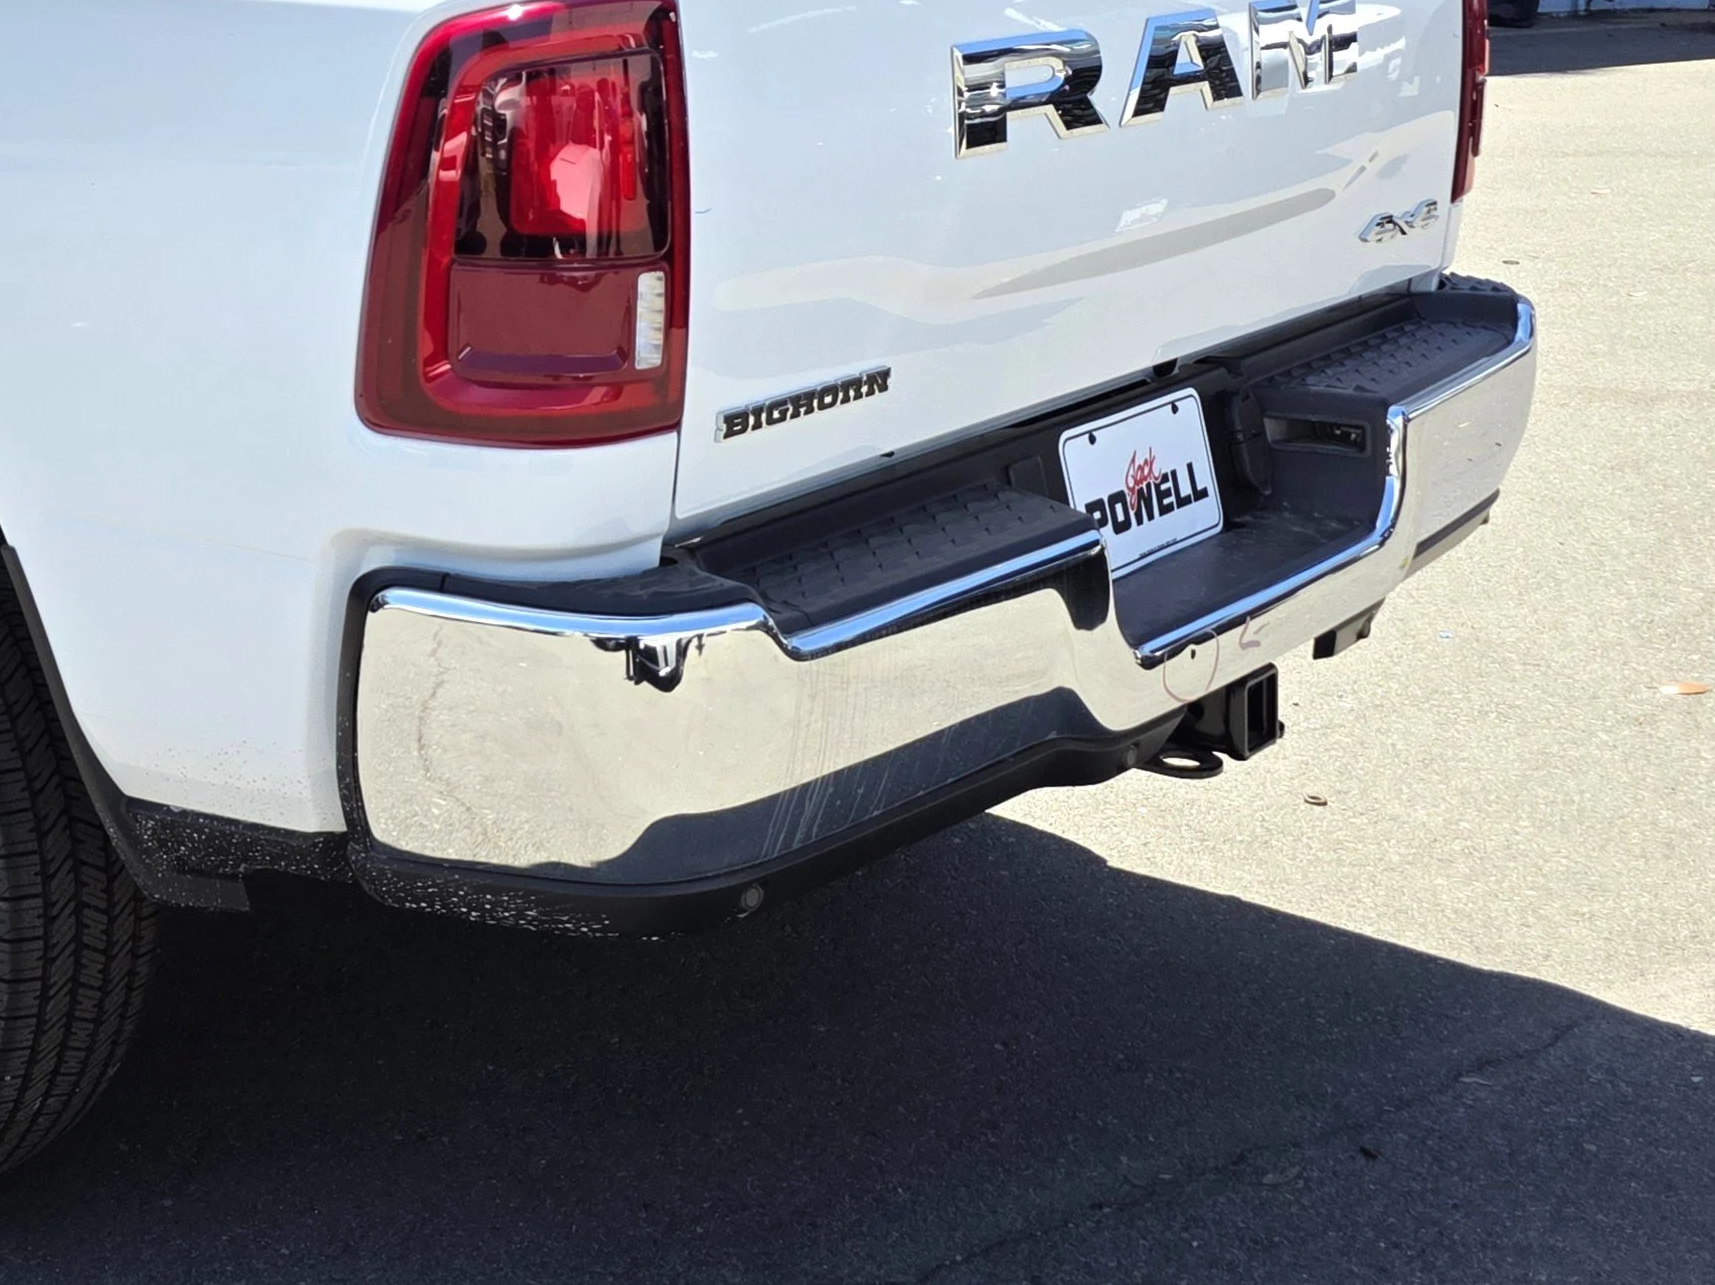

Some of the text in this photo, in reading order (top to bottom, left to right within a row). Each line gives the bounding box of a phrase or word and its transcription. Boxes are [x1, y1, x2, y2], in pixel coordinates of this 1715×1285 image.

[714, 365, 891, 443] BIGHORN
[1084, 462, 1209, 535] POWELL
[1125, 446, 1162, 513] Jack
